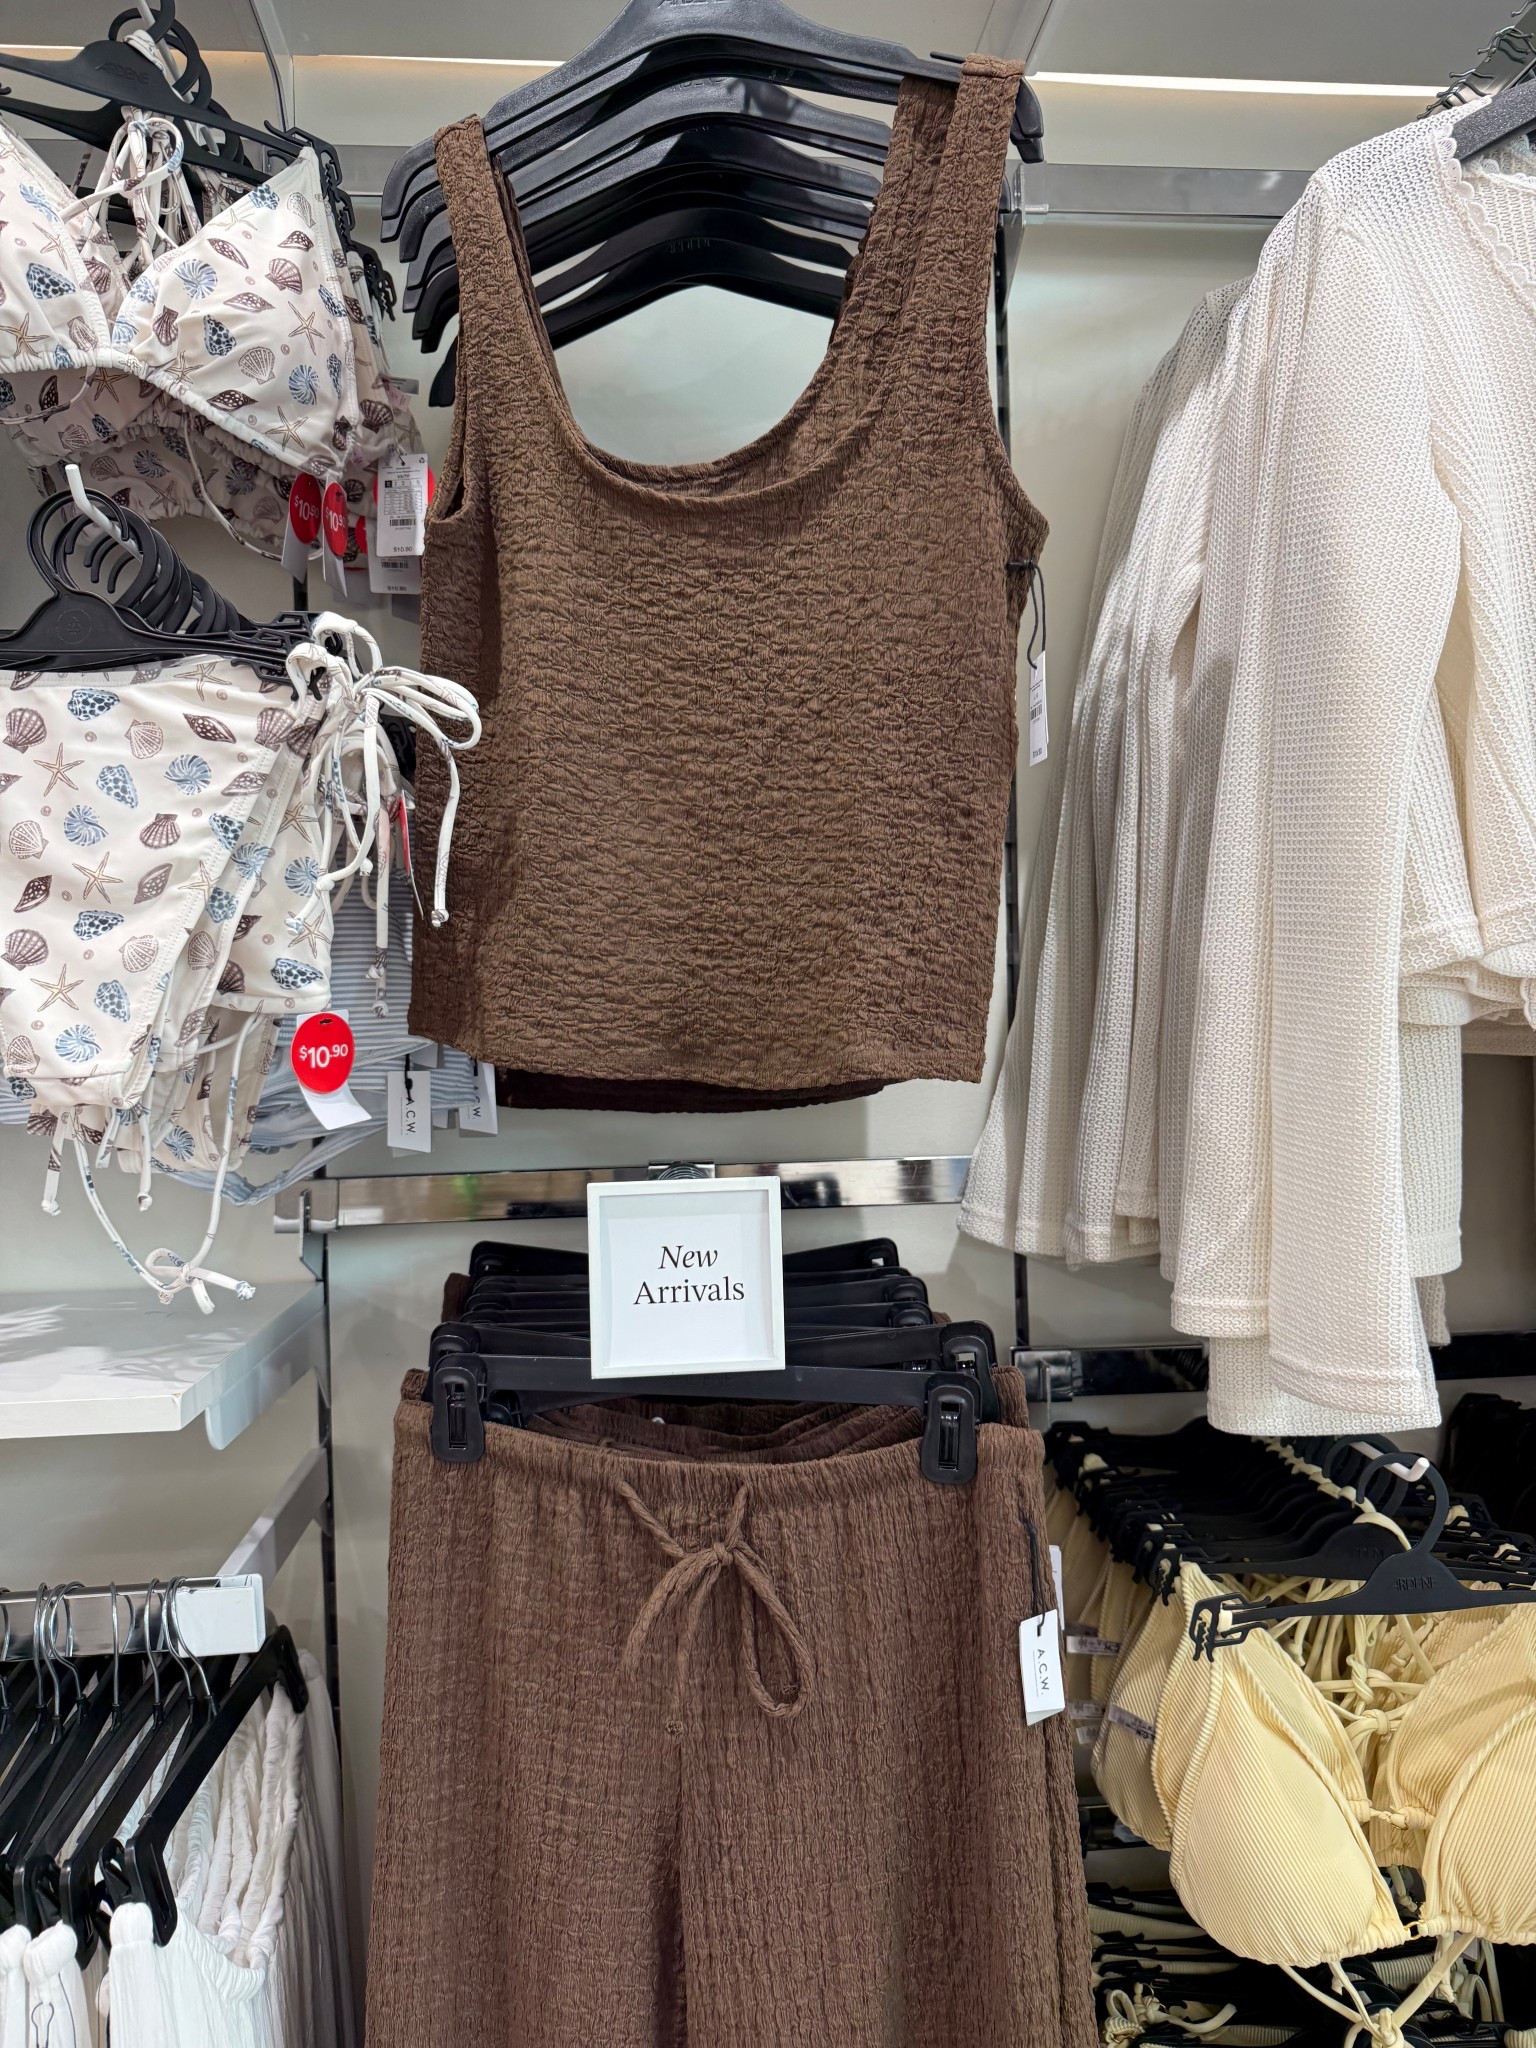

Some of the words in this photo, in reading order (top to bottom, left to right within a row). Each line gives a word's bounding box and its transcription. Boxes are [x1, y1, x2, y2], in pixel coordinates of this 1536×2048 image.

[299, 1044, 349, 1069] $10.90
[657, 1245, 718, 1269] New
[633, 1275, 745, 1305] Arrivals
[1037, 1648, 1050, 1696] A.C.W.
